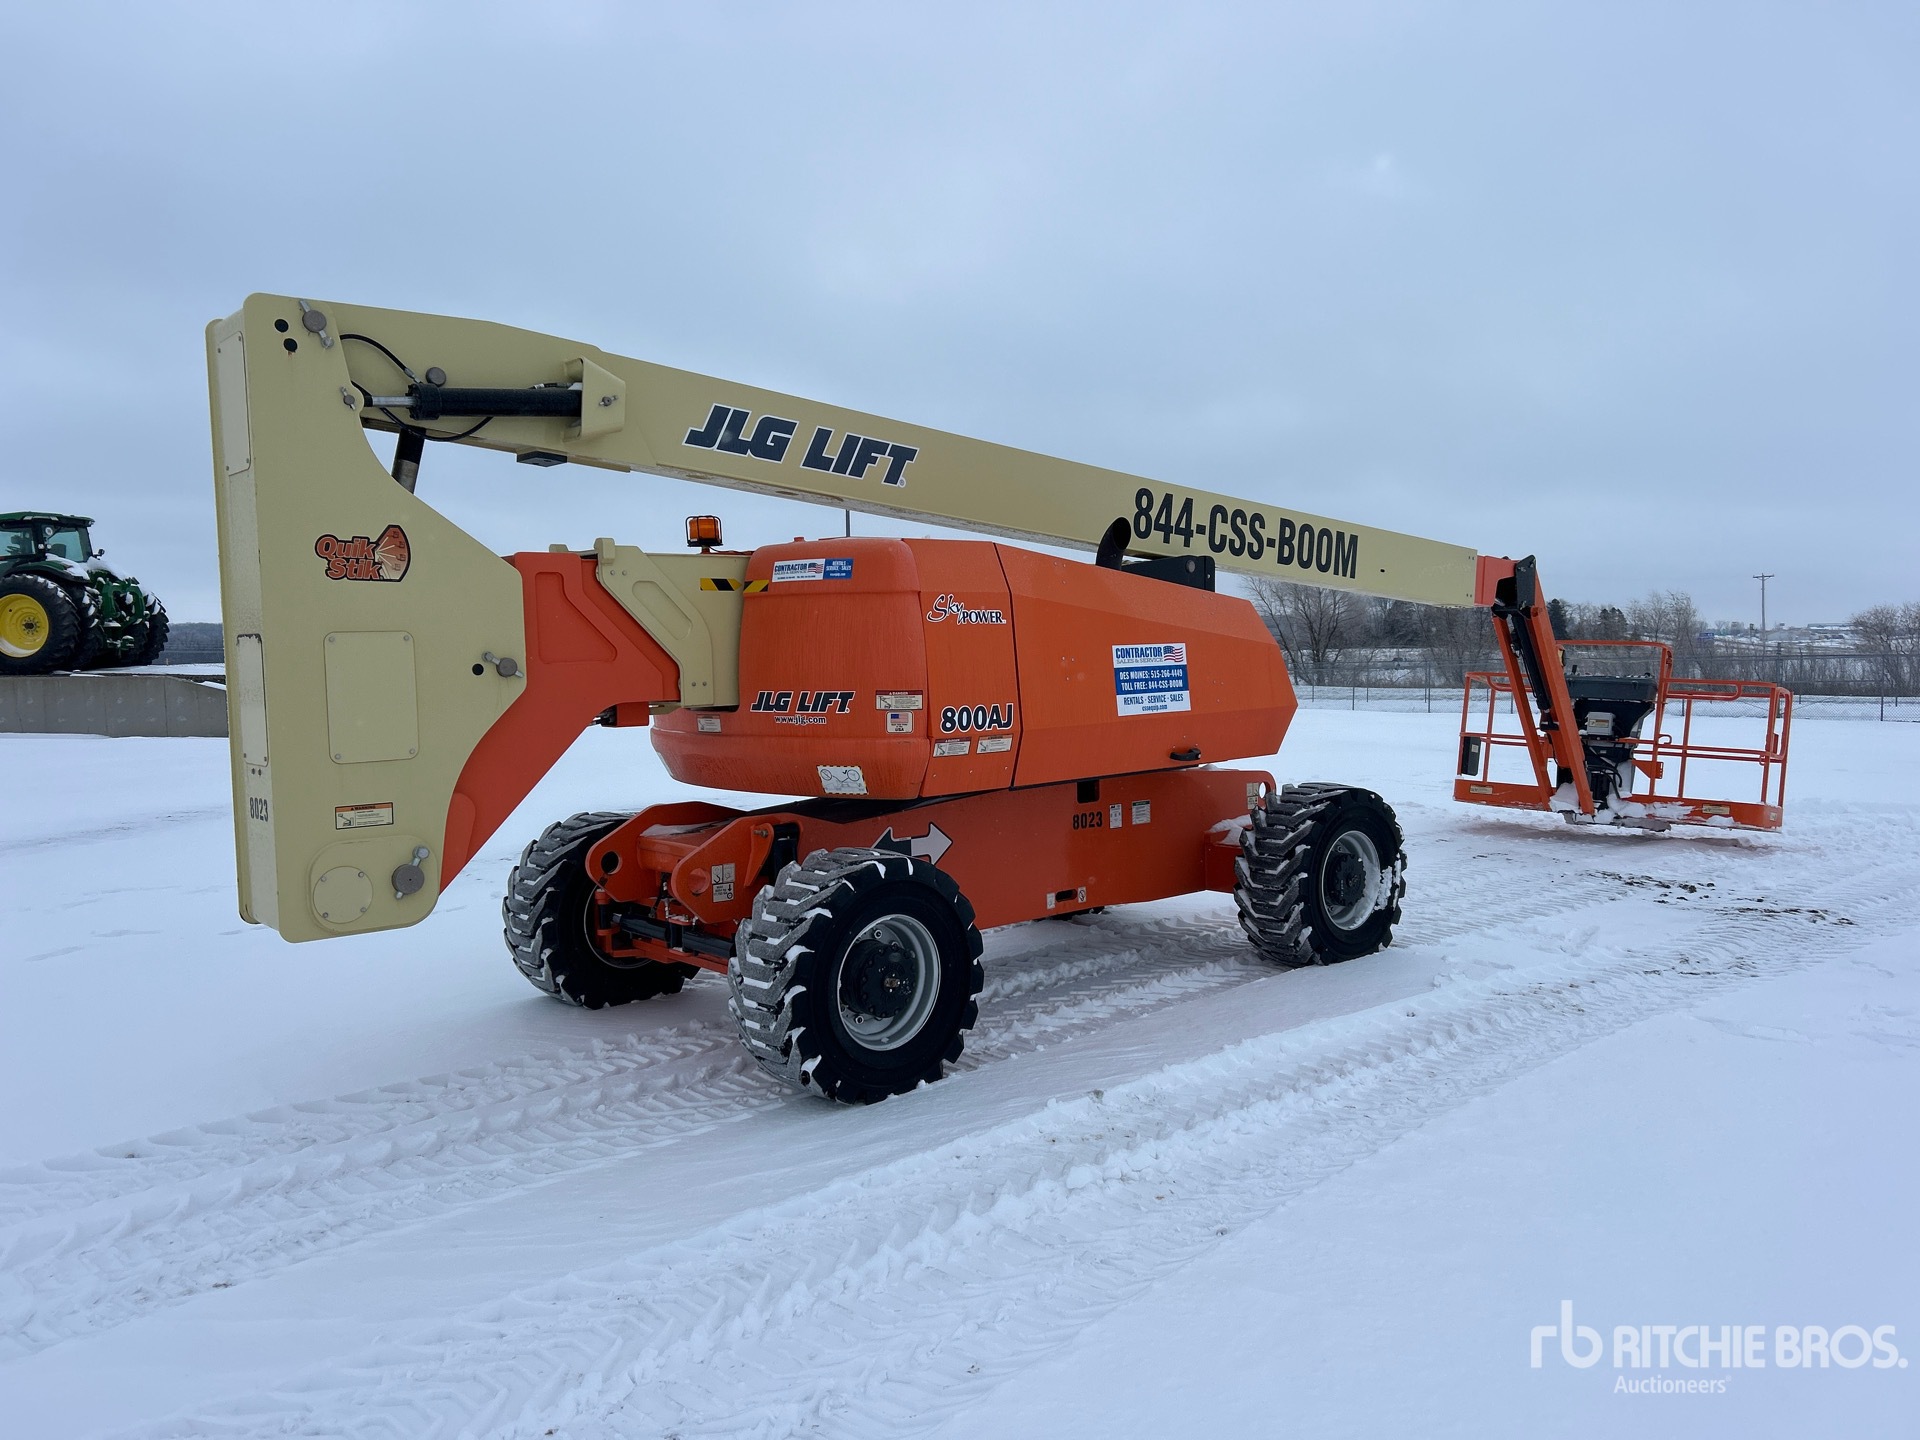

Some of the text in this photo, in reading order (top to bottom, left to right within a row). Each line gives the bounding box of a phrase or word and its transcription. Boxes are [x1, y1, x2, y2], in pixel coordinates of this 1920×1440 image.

[682, 403, 799, 463] JLG
[1133, 488, 1358, 579] 844-CSS-BOOM
[317, 536, 376, 560] Quik
[328, 558, 381, 579] Stik
[775, 563, 808, 572] CONTRACTOR
[927, 594, 1003, 625] Sky POWER
[1115, 647, 1163, 659] CONTRACTOR
[1120, 671, 1130, 680] DES
[1130, 670, 1150, 680] MOINES:
[1121, 679, 1183, 691] TOLL FREE: 844-CSS-BOOM
[750, 691, 793, 712] JLG
[1123, 693, 1184, 705] RENTALS SERVICE SALES
[774, 715, 827, 725] www.jlg.com
[940, 703, 1014, 733] 800AJ
[250, 797, 268, 822] 8023
[1072, 811, 1103, 830] 8023
